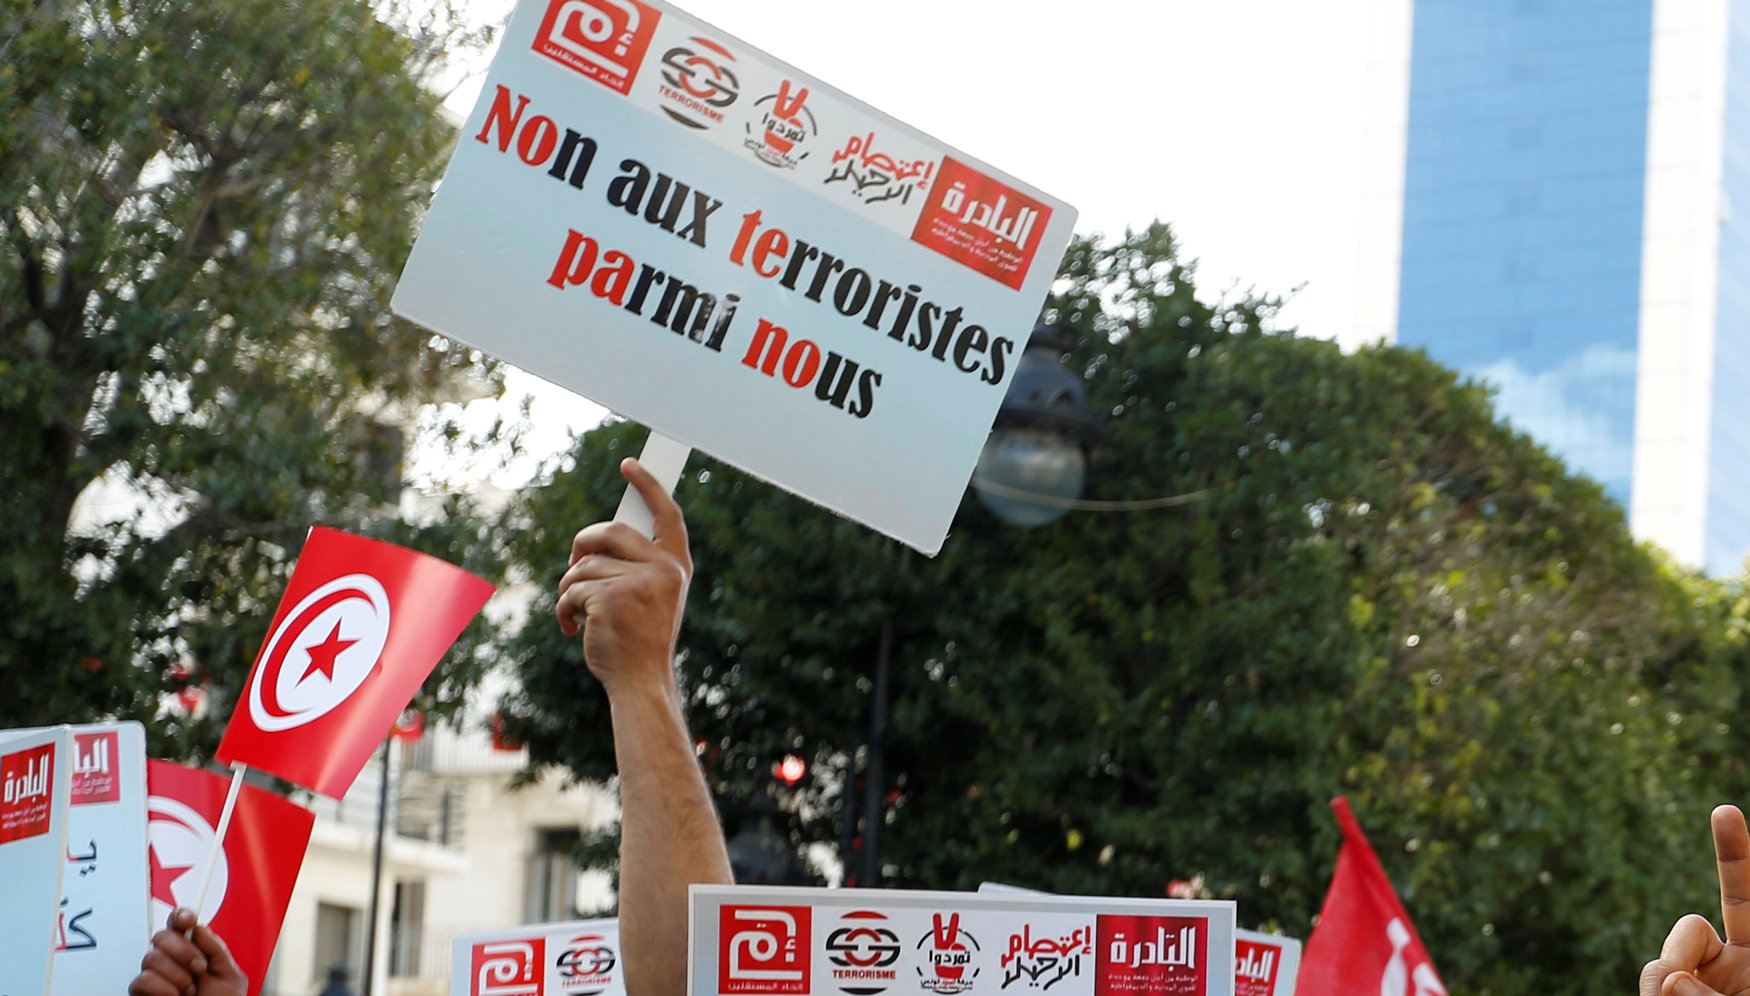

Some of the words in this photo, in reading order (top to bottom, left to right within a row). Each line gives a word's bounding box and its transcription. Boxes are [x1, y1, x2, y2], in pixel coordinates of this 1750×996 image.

[658, 84, 724, 124] TERRORISME
[474, 83, 598, 189] Non
[607, 157, 723, 248] aux
[729, 208, 1014, 387] terroristes
[547, 227, 740, 353] parmi
[741, 317, 882, 419] nous
[832, 969, 896, 980] TERRORISME
[929, 950, 971, 965] تمردوا
[1235, 947, 1274, 983] الباد
